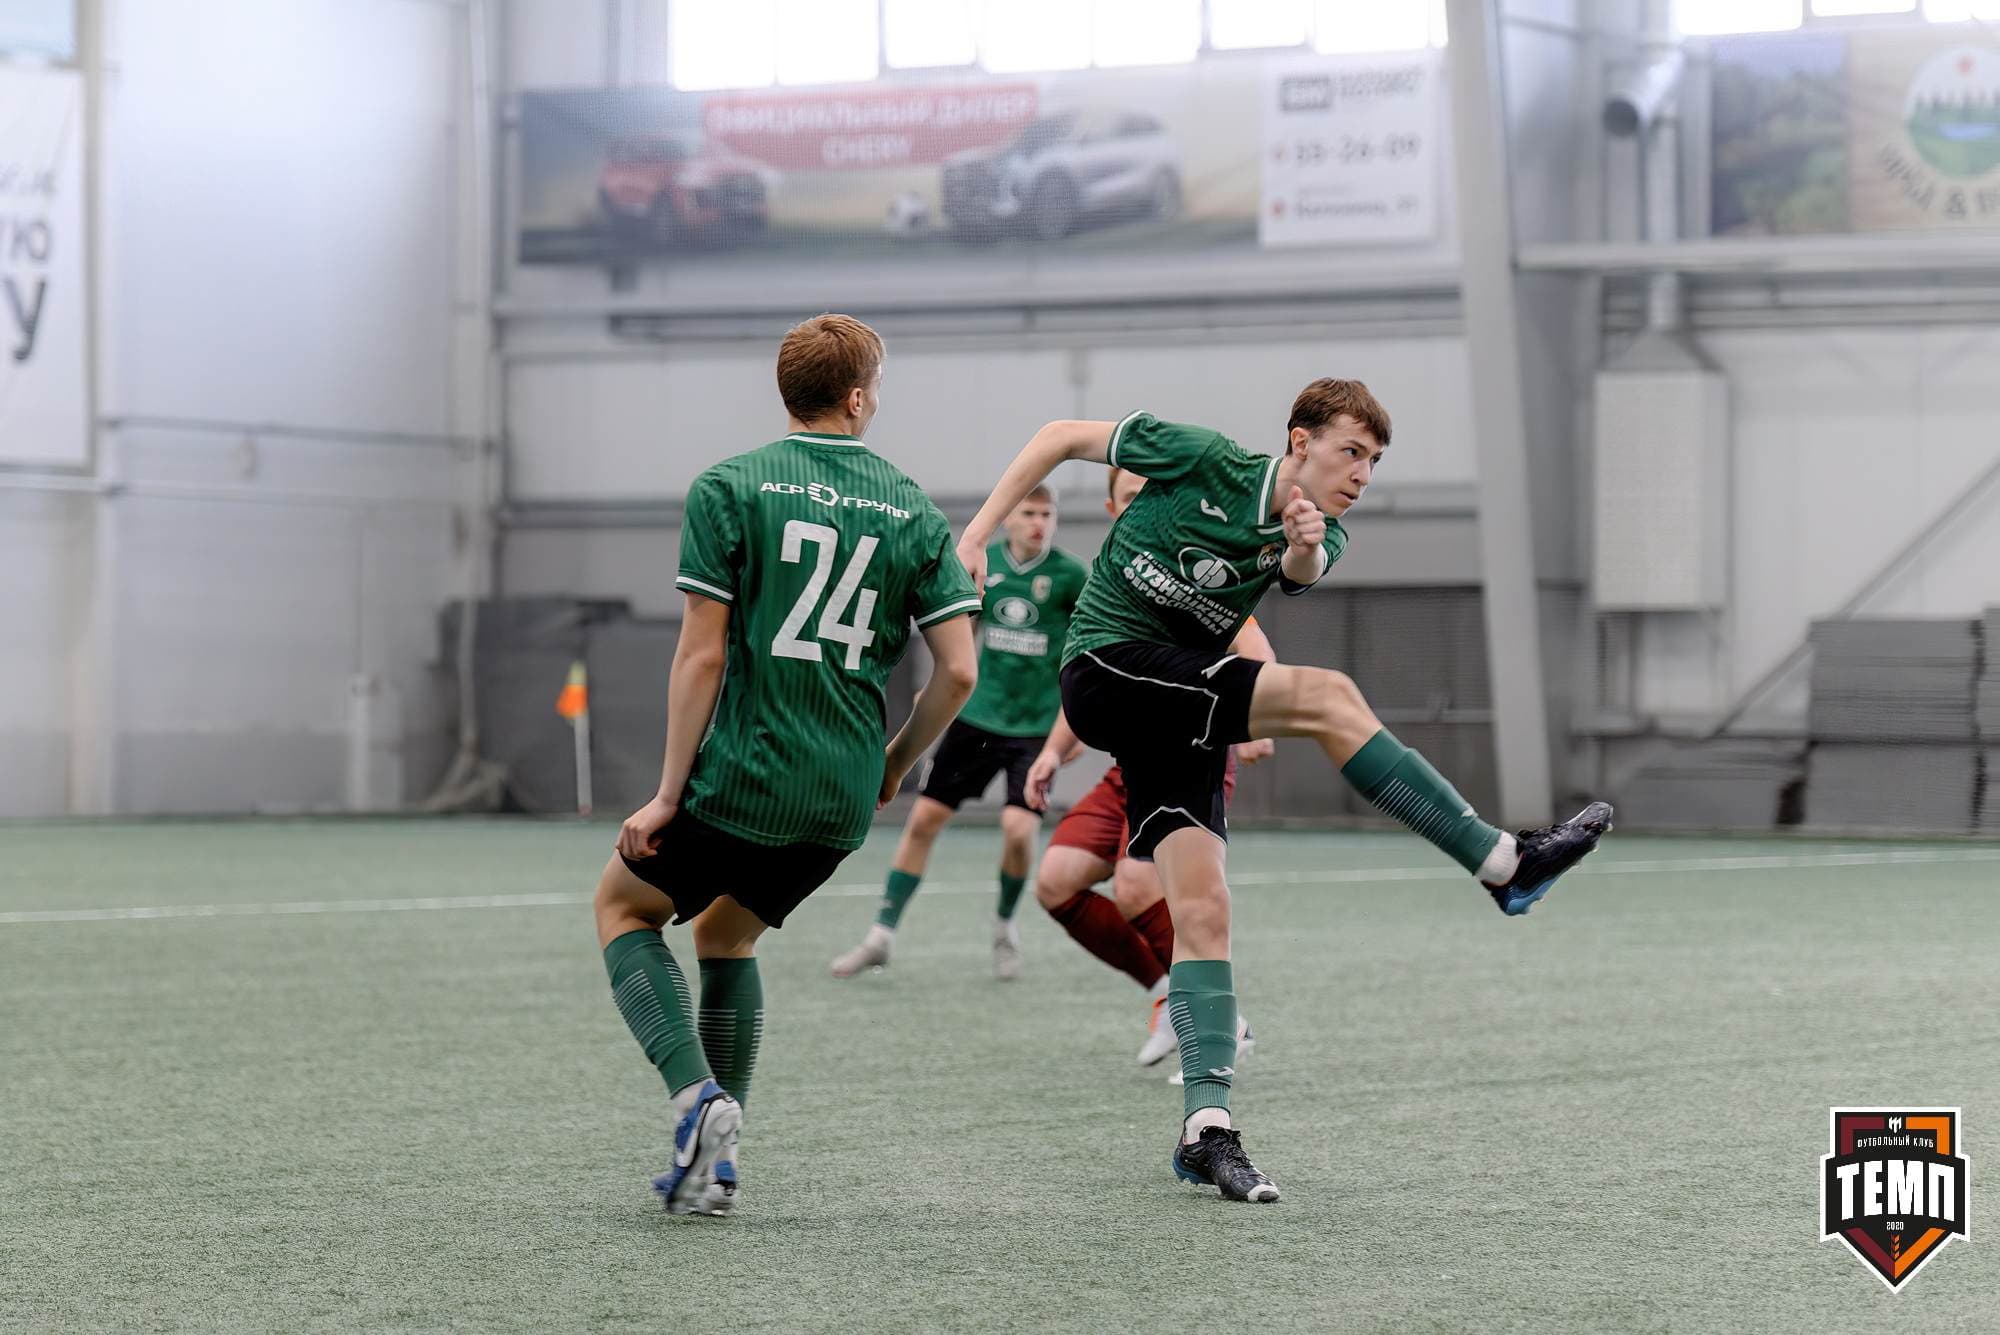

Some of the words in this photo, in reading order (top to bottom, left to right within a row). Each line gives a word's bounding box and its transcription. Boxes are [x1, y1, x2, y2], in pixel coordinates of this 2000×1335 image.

[760, 482, 805, 495] АСР
[842, 496, 911, 519] ГРУПП
[771, 519, 880, 671] 24
[1131, 554, 1235, 630] КУЗНЕЦКИЕ
